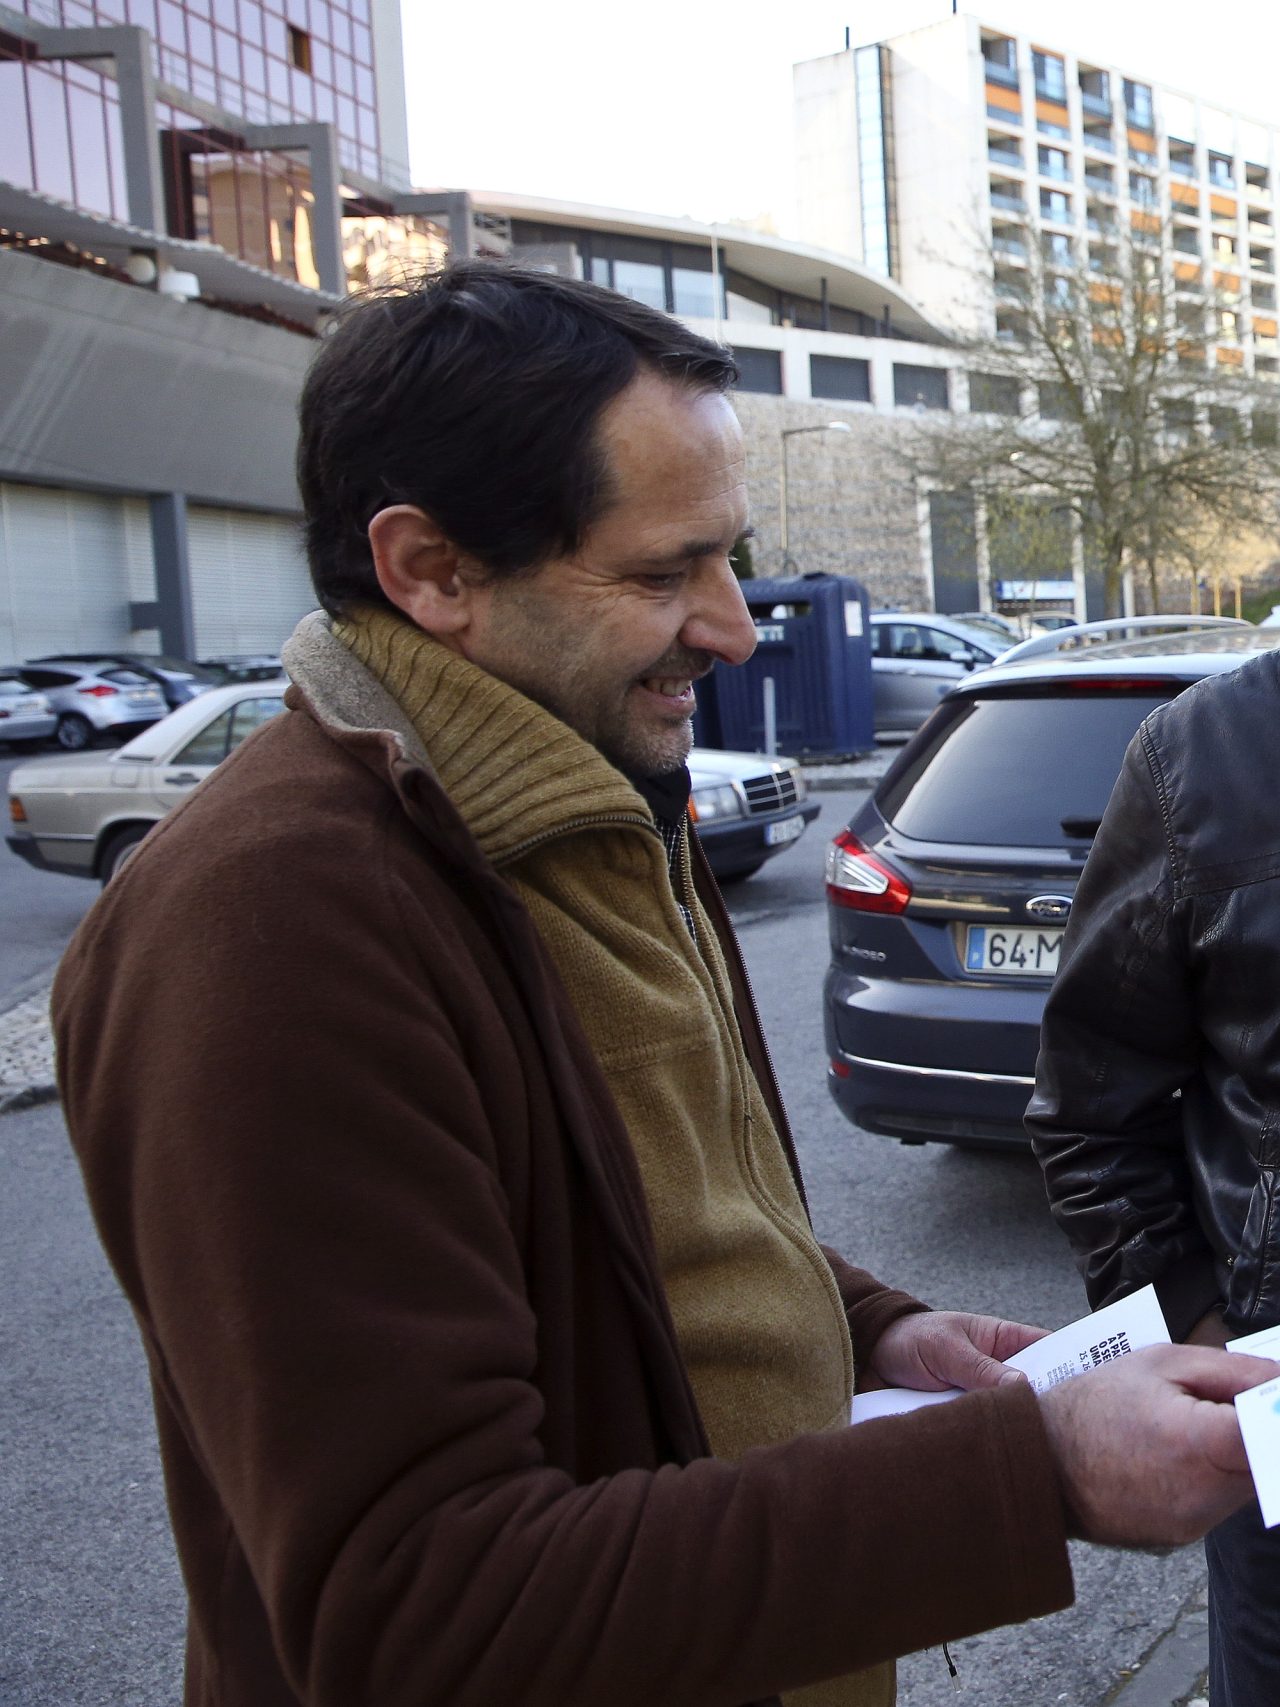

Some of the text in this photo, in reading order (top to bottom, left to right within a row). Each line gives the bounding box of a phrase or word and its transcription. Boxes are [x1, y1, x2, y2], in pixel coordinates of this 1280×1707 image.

[1108, 1336, 1117, 1344] A
[1120, 1339, 1131, 1355] LUT
[1090, 1345, 1102, 1367] UMA
[1082, 1361, 1091, 1372] 26
